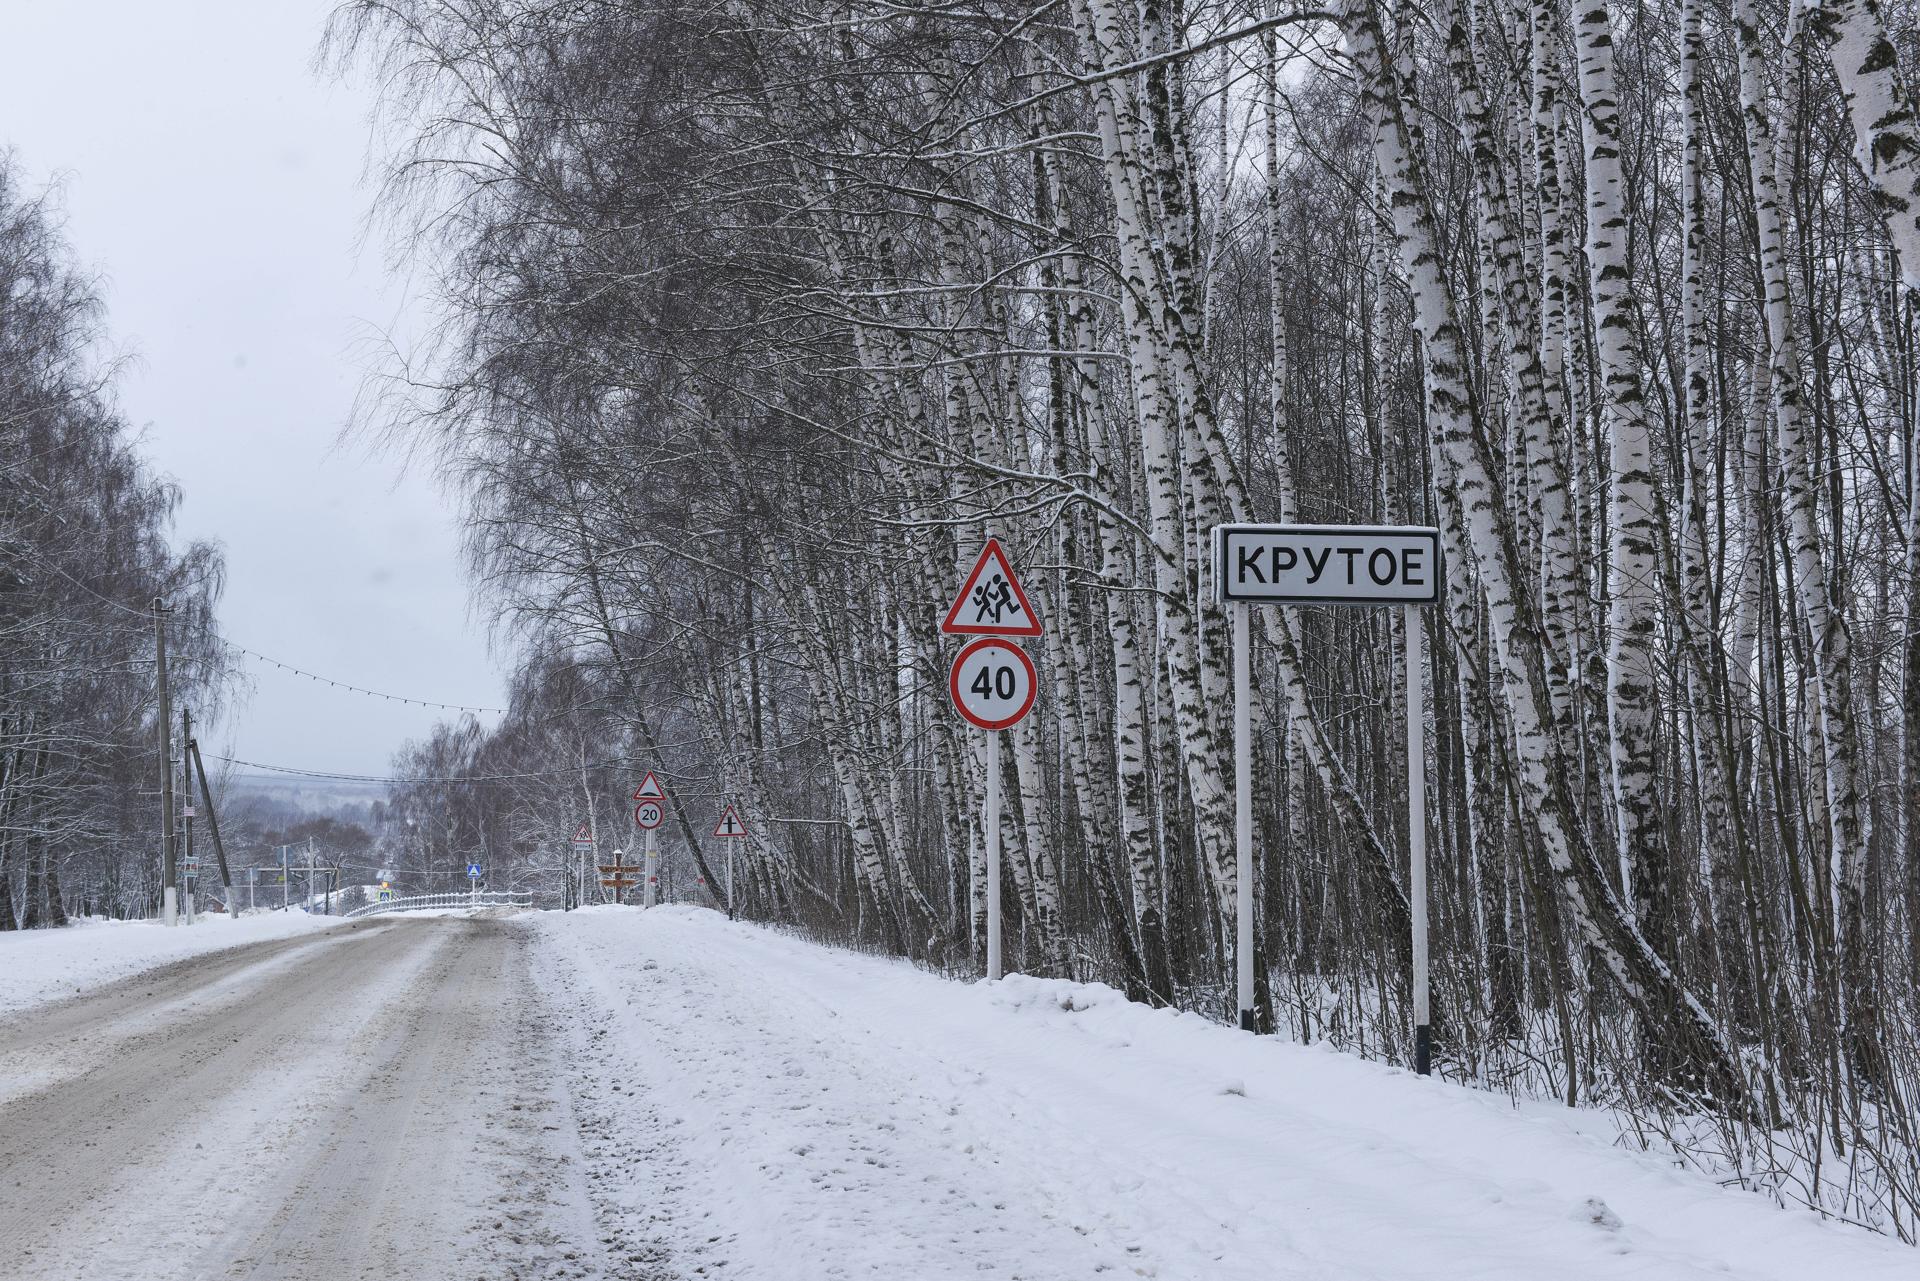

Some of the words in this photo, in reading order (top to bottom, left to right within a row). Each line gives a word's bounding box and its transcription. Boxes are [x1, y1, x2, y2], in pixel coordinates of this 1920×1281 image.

[1238, 545, 1424, 586] КРУТОЕ
[971, 666, 1015, 700] 40
[642, 809, 657, 820] 20
